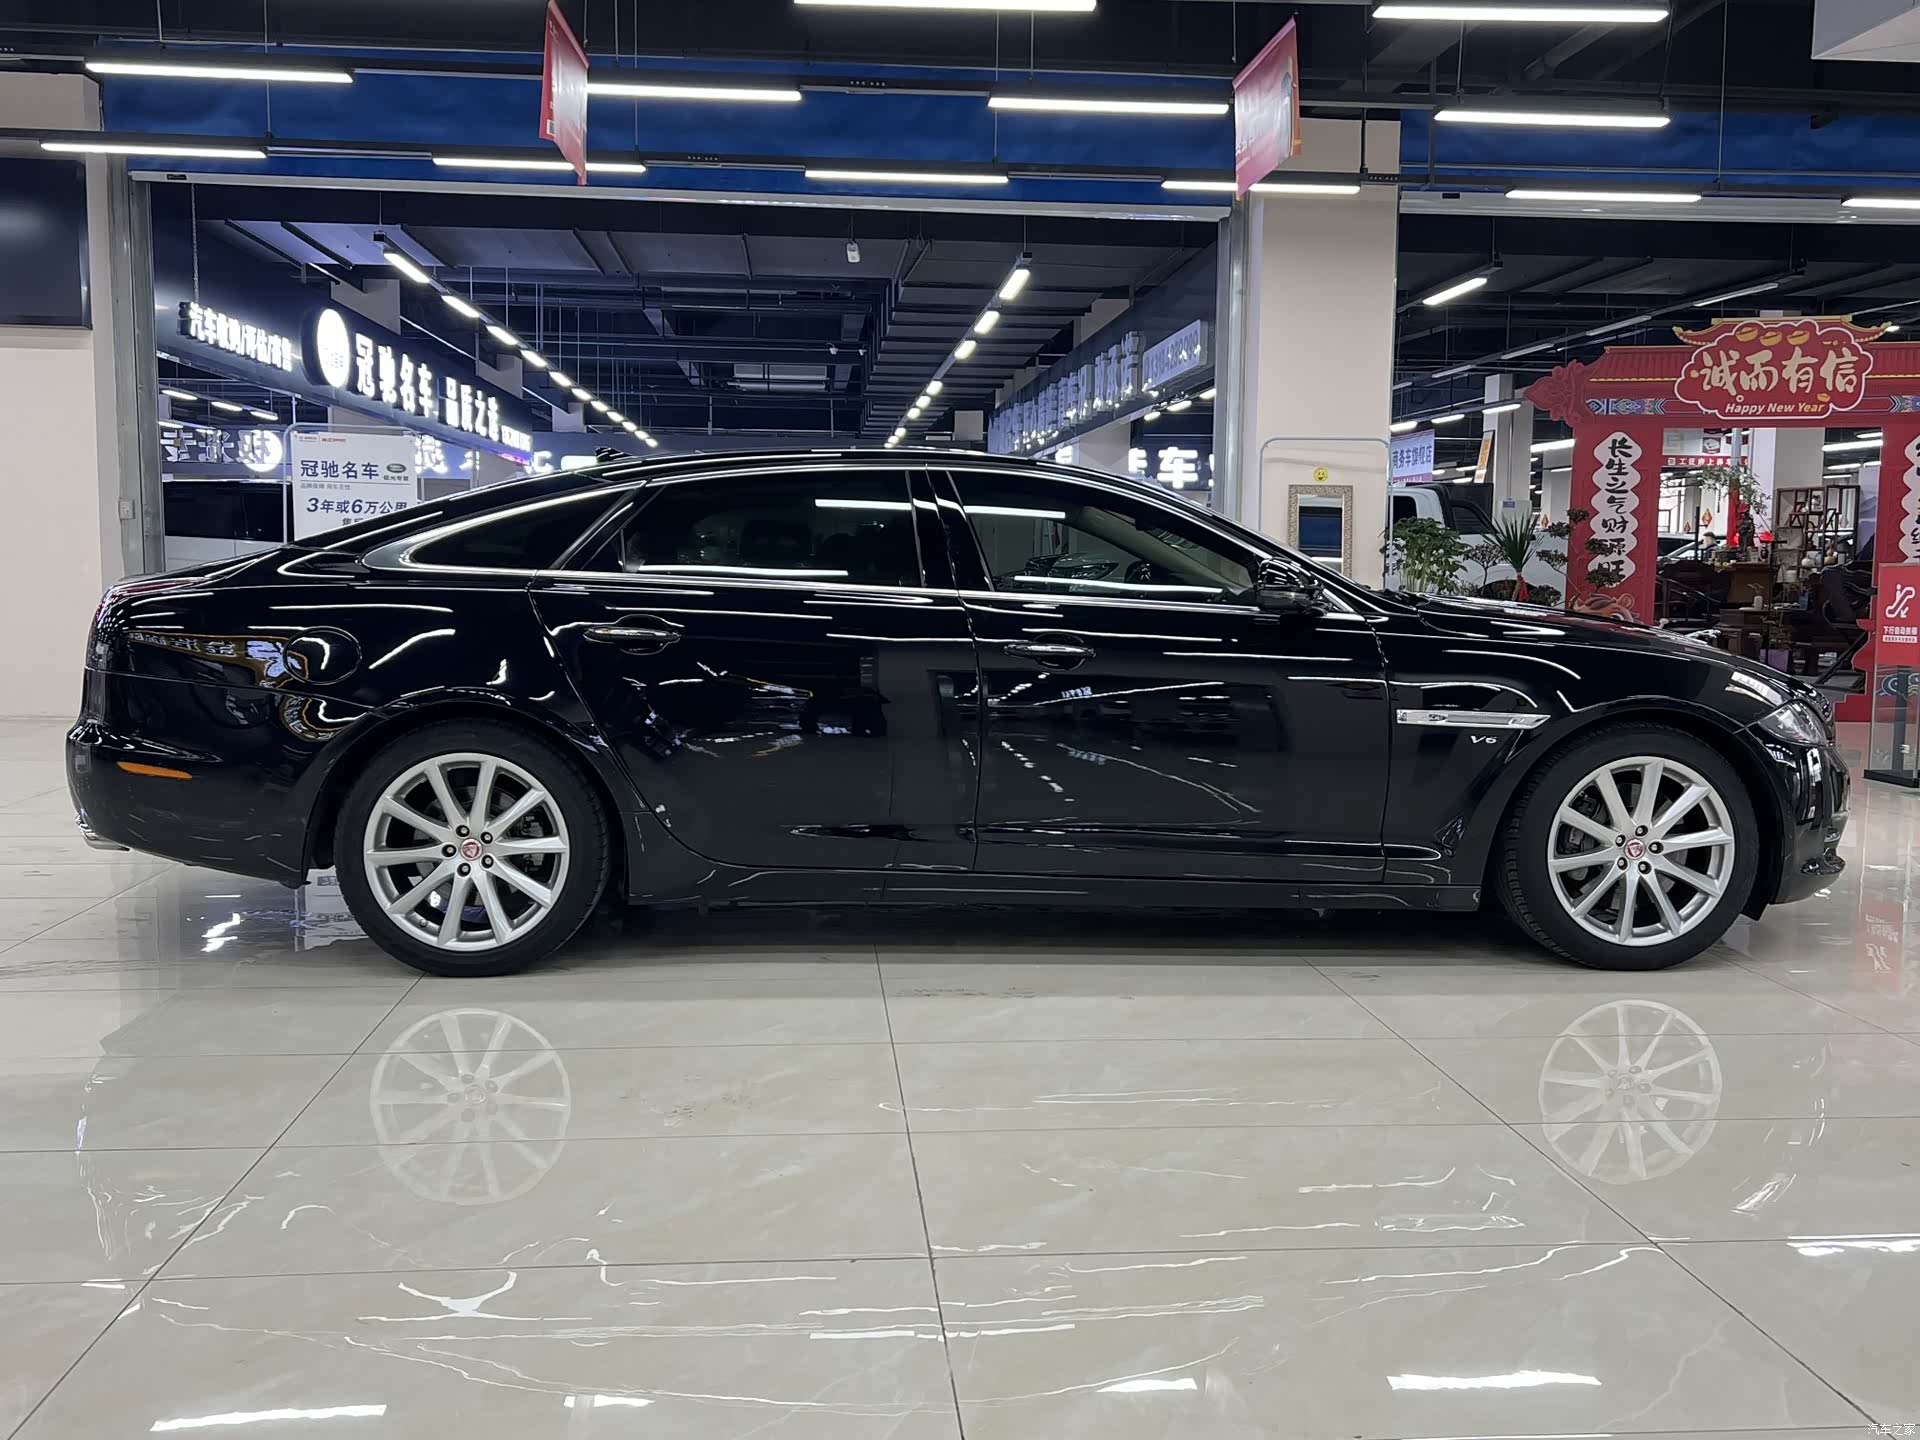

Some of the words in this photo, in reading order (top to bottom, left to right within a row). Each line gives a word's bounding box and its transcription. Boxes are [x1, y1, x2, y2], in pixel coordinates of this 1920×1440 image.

[355, 332, 434, 418] 冠驰名车
[1699, 346, 1860, 396] 诚而有信
[1725, 403, 1765, 415] Happy
[1767, 403, 1795, 413] New
[1797, 402, 1825, 413] Year
[1392, 444, 1432, 469] 商务车旗舰店
[300, 460, 380, 480] 冠驰名车
[306, 497, 408, 515] 3年或6万公里
[1470, 735, 1498, 745] V6
